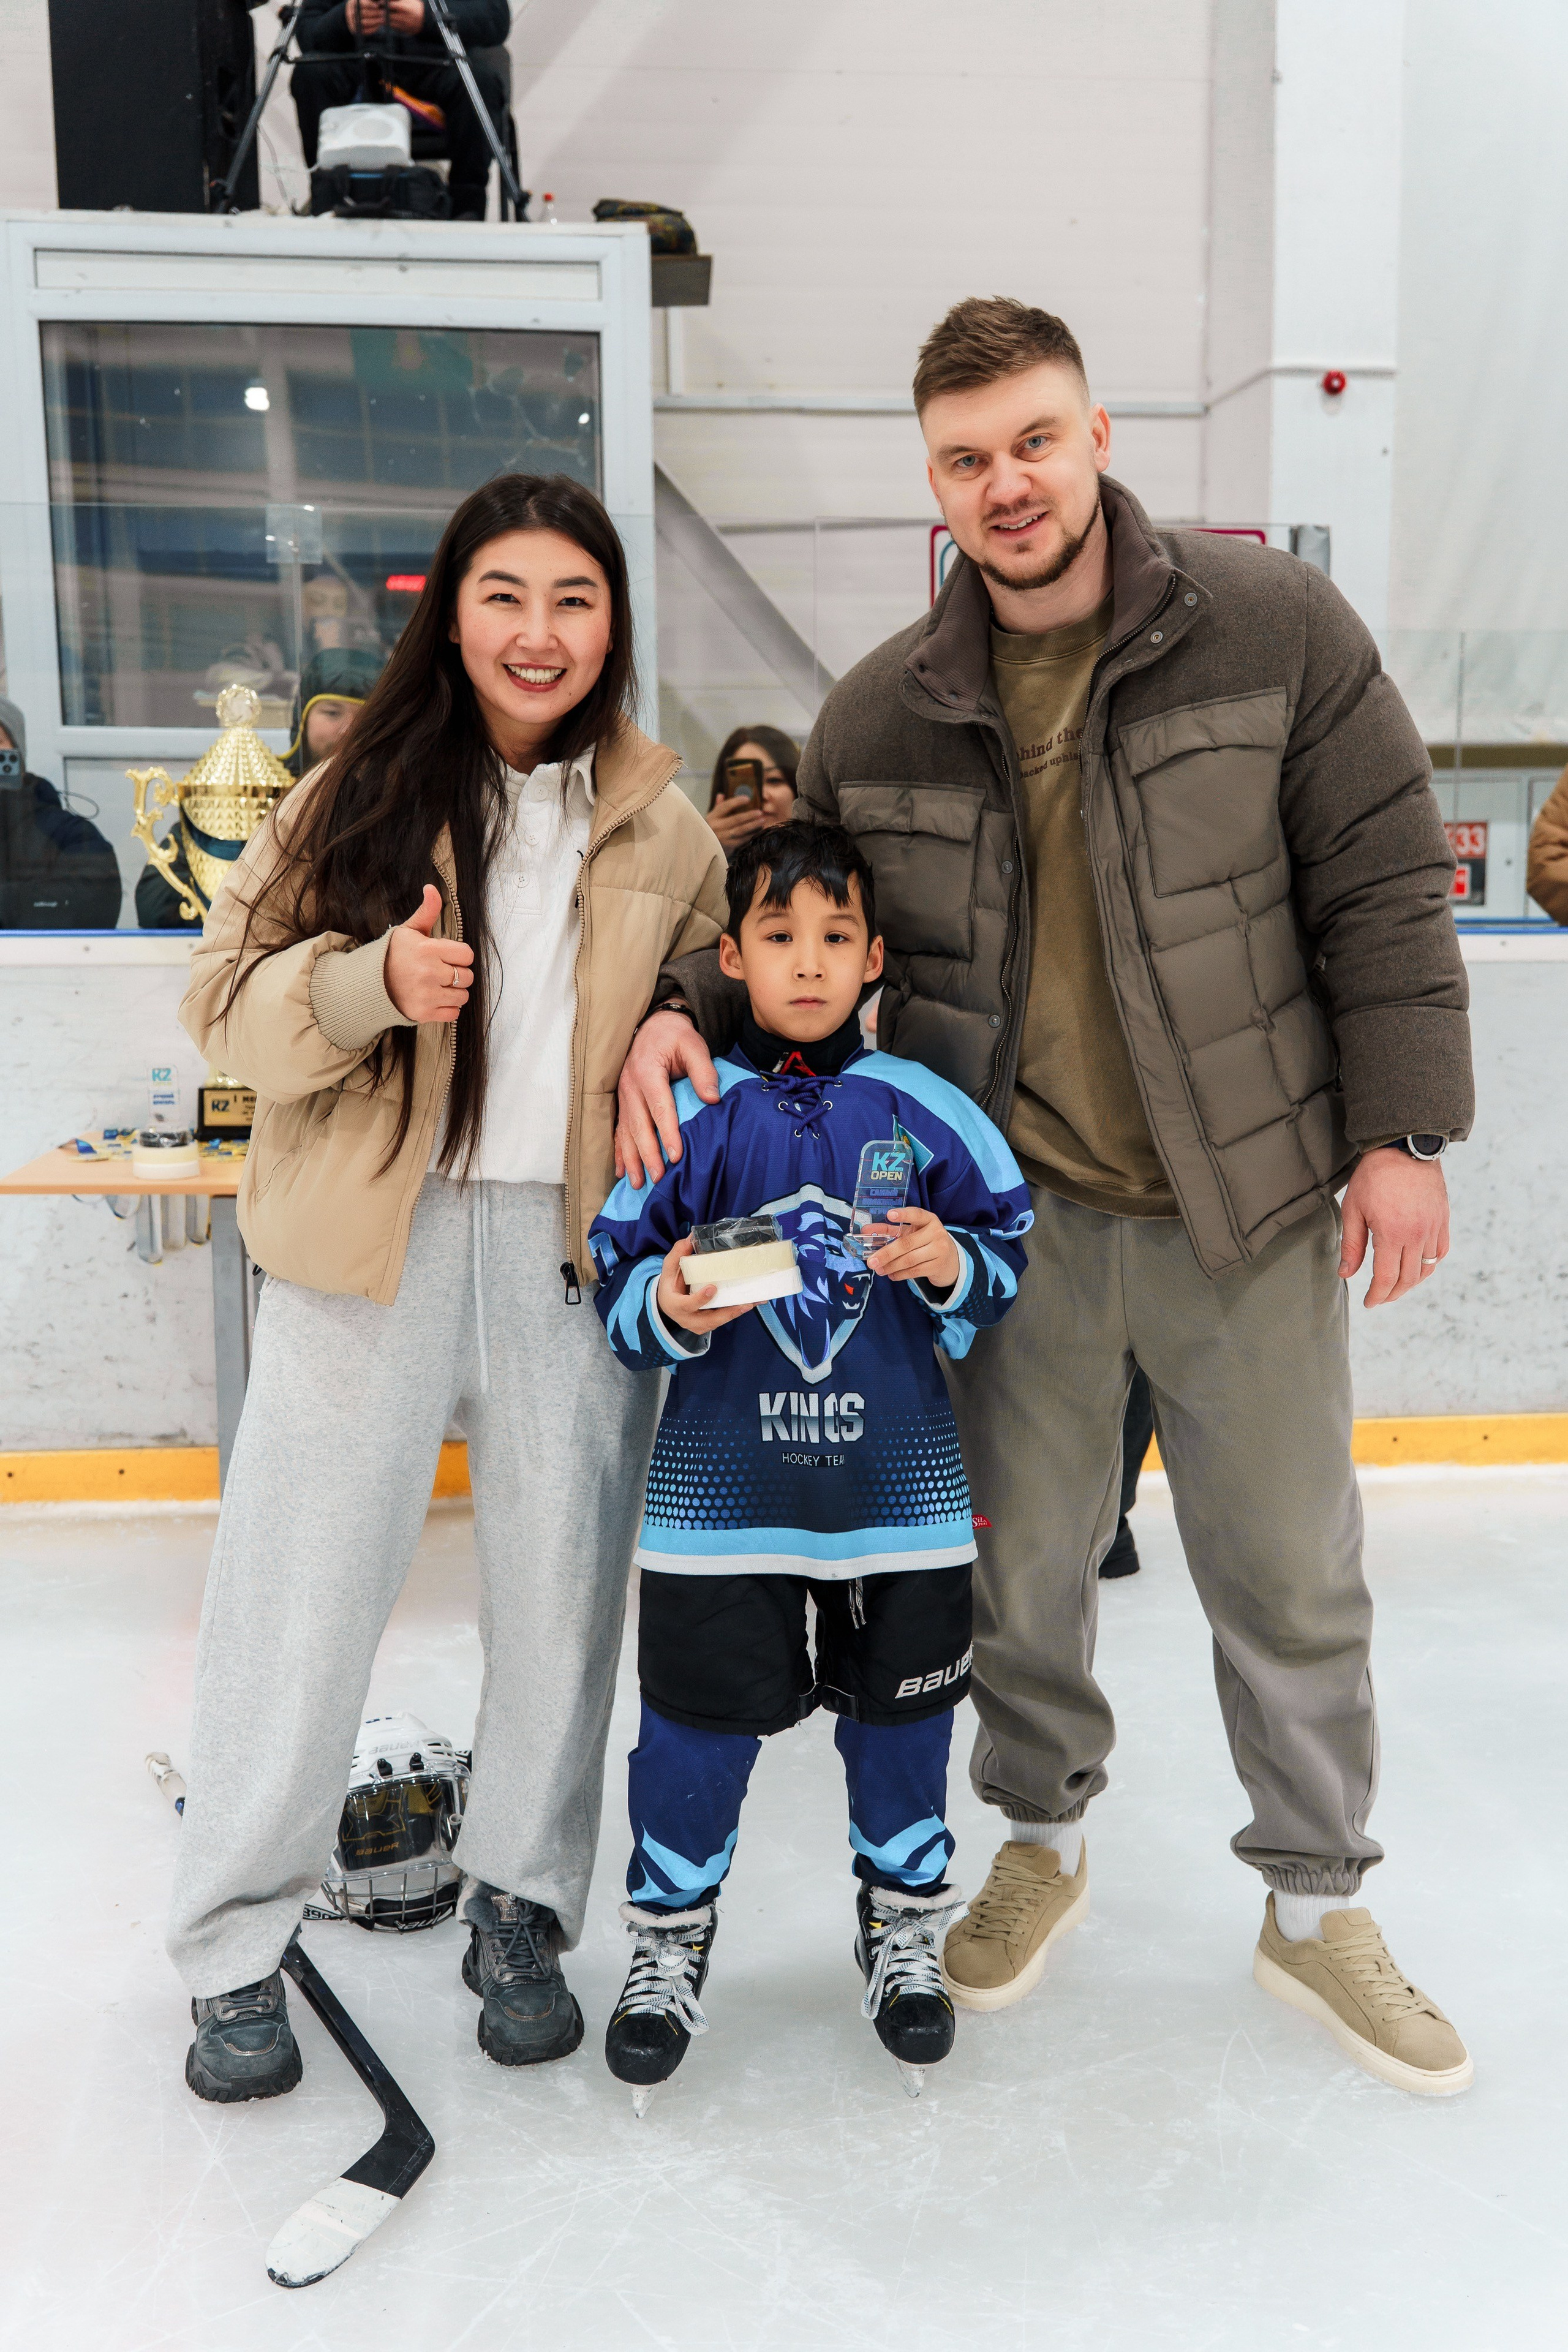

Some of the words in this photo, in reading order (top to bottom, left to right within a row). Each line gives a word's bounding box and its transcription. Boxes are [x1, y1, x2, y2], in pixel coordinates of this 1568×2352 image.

[1017, 736, 1053, 761] hind
[152, 1068, 172, 1081] KZ
[211, 1099, 230, 1112] KZ
[872, 1152, 905, 1171] KZ
[871, 1171, 903, 1180] OPEN
[759, 1392, 865, 1444] KINGS
[782, 1453, 820, 1466] HOCKEY
[825, 1455, 844, 1466] TEA
